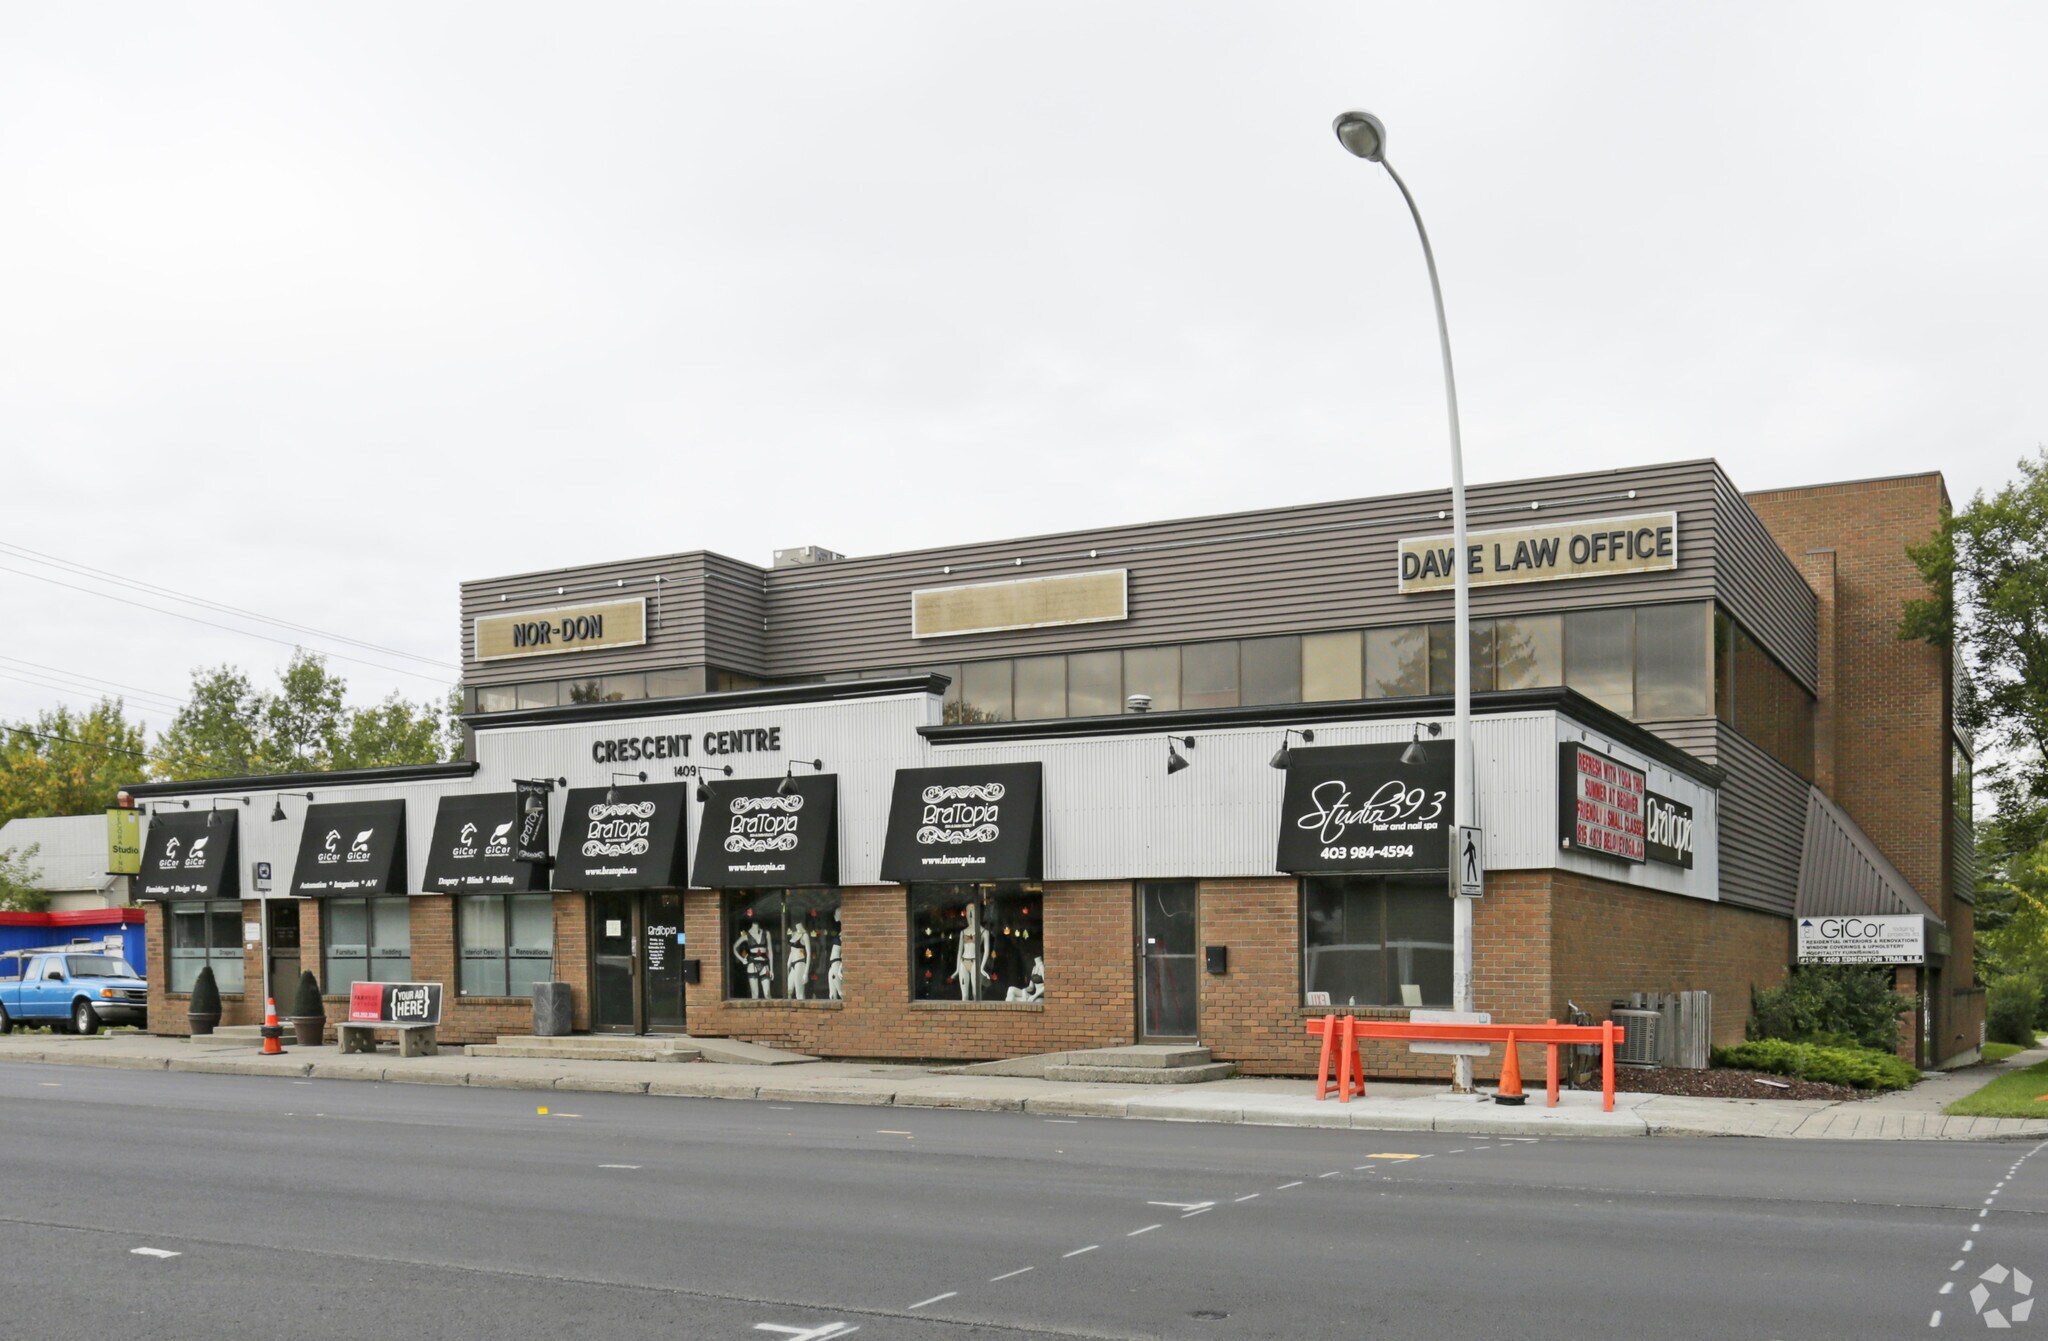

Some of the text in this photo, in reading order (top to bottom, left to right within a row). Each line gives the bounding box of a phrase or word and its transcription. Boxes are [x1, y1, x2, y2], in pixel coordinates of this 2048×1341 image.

[1494, 537, 1560, 572] LAW
[1568, 526, 1673, 565] OFFICE
[513, 614, 603, 648] NOR-DON
[592, 727, 781, 763] CRESCENT CENTRE
[673, 765, 696, 777] 1409
[1577, 752, 1643, 795] REFRESH WITH YOGA THIS
[1584, 778, 1607, 802] SUMMER
[1608, 787, 1616, 805] AT
[922, 803, 999, 827] BraTopia
[1607, 809, 1624, 831] SMALL
[587, 819, 650, 841] BraTopia
[730, 813, 798, 836] BraTopia
[1372, 821, 1438, 831] hair and nail spa
[1647, 798, 1693, 860] BraTopia
[112, 845, 139, 854] Studio
[347, 852, 371, 860] GiCor
[453, 847, 478, 855] GiCor
[485, 846, 511, 854] GiCor
[1320, 845, 1414, 859] 403 984-4594
[185, 858, 206, 866] GiCor
[318, 853, 341, 861] GiCor
[921, 855, 986, 866] www.bratopia.ca
[585, 866, 638, 877] www.bratopia.ca
[728, 862, 786, 874] www.bratopia.ca
[1820, 918, 1885, 939] GiCor
[515, 948, 549, 956] Renovations
[397, 989, 424, 1001] YOUR AD
[397, 1000, 424, 1017] HERE
